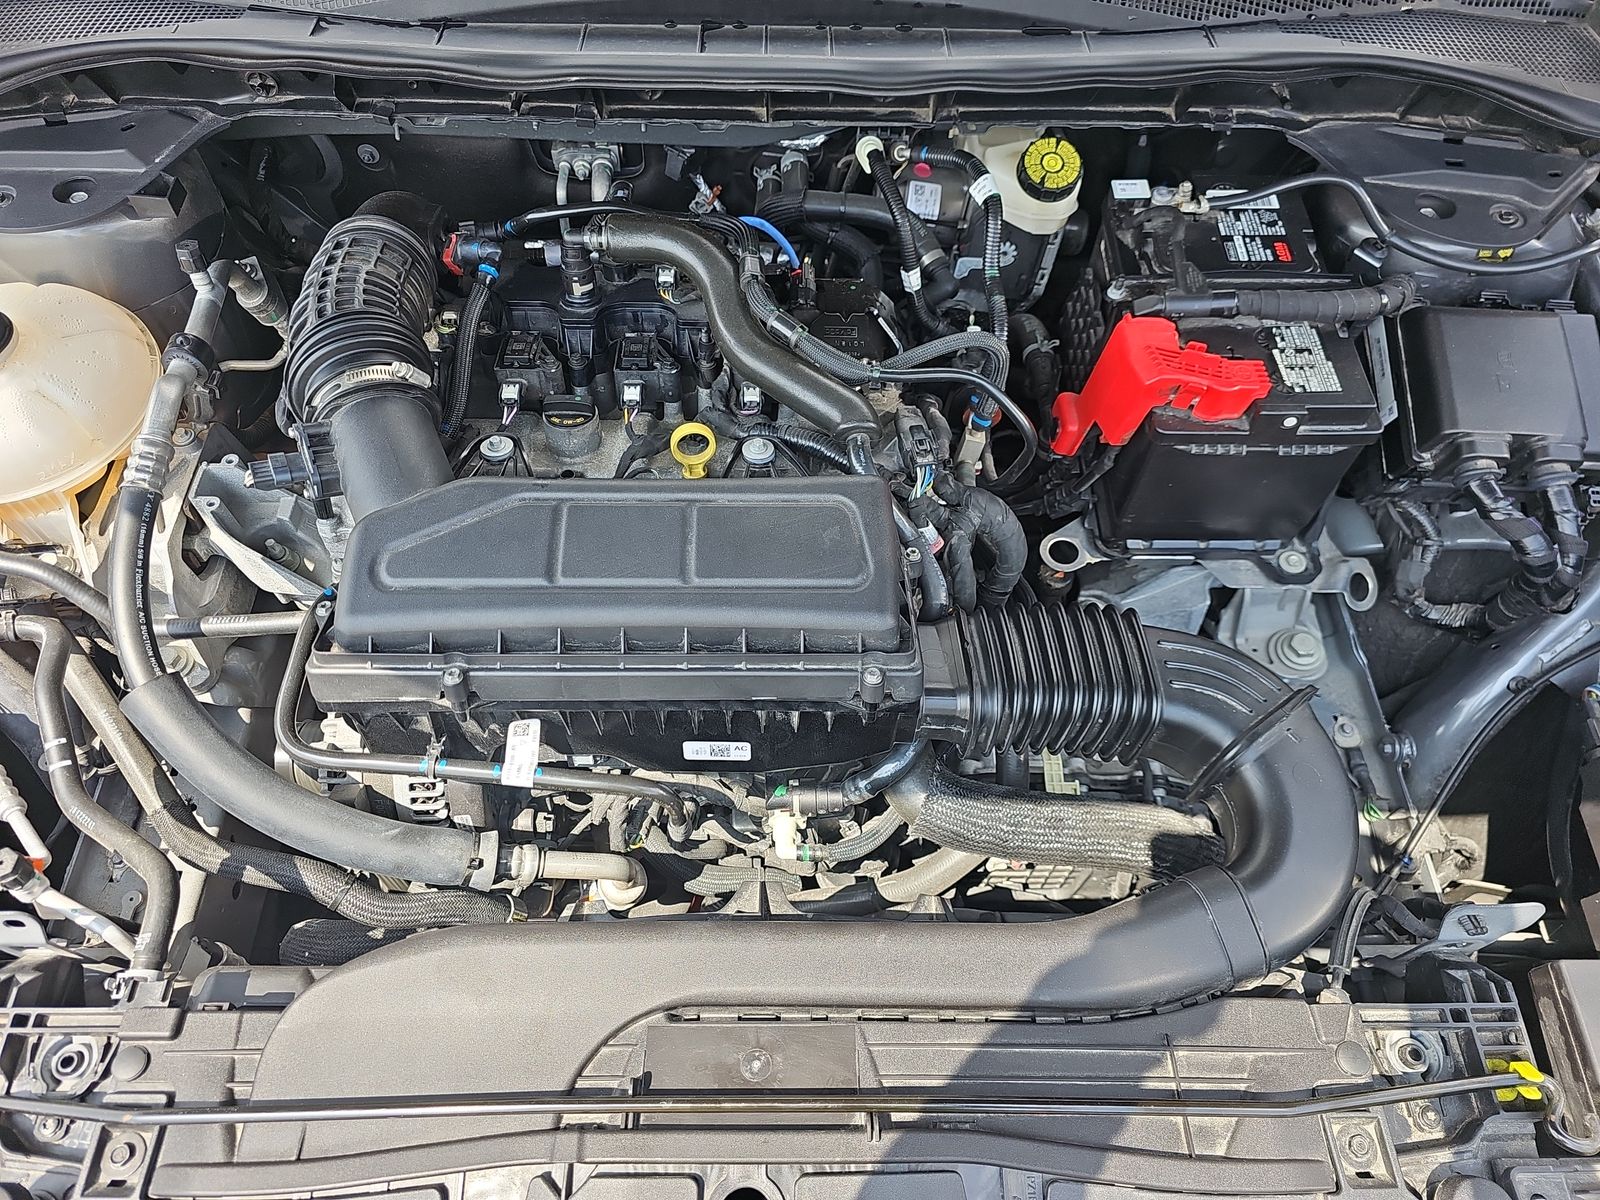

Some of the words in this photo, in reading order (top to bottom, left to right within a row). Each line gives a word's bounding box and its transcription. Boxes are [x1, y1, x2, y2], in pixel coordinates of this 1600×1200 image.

[141, 502, 152, 522] 4882
[138, 522, 148, 548] (16mm)
[138, 611, 147, 625] A/C
[140, 625, 154, 657] SUCTION
[149, 657, 164, 677] HOSE
